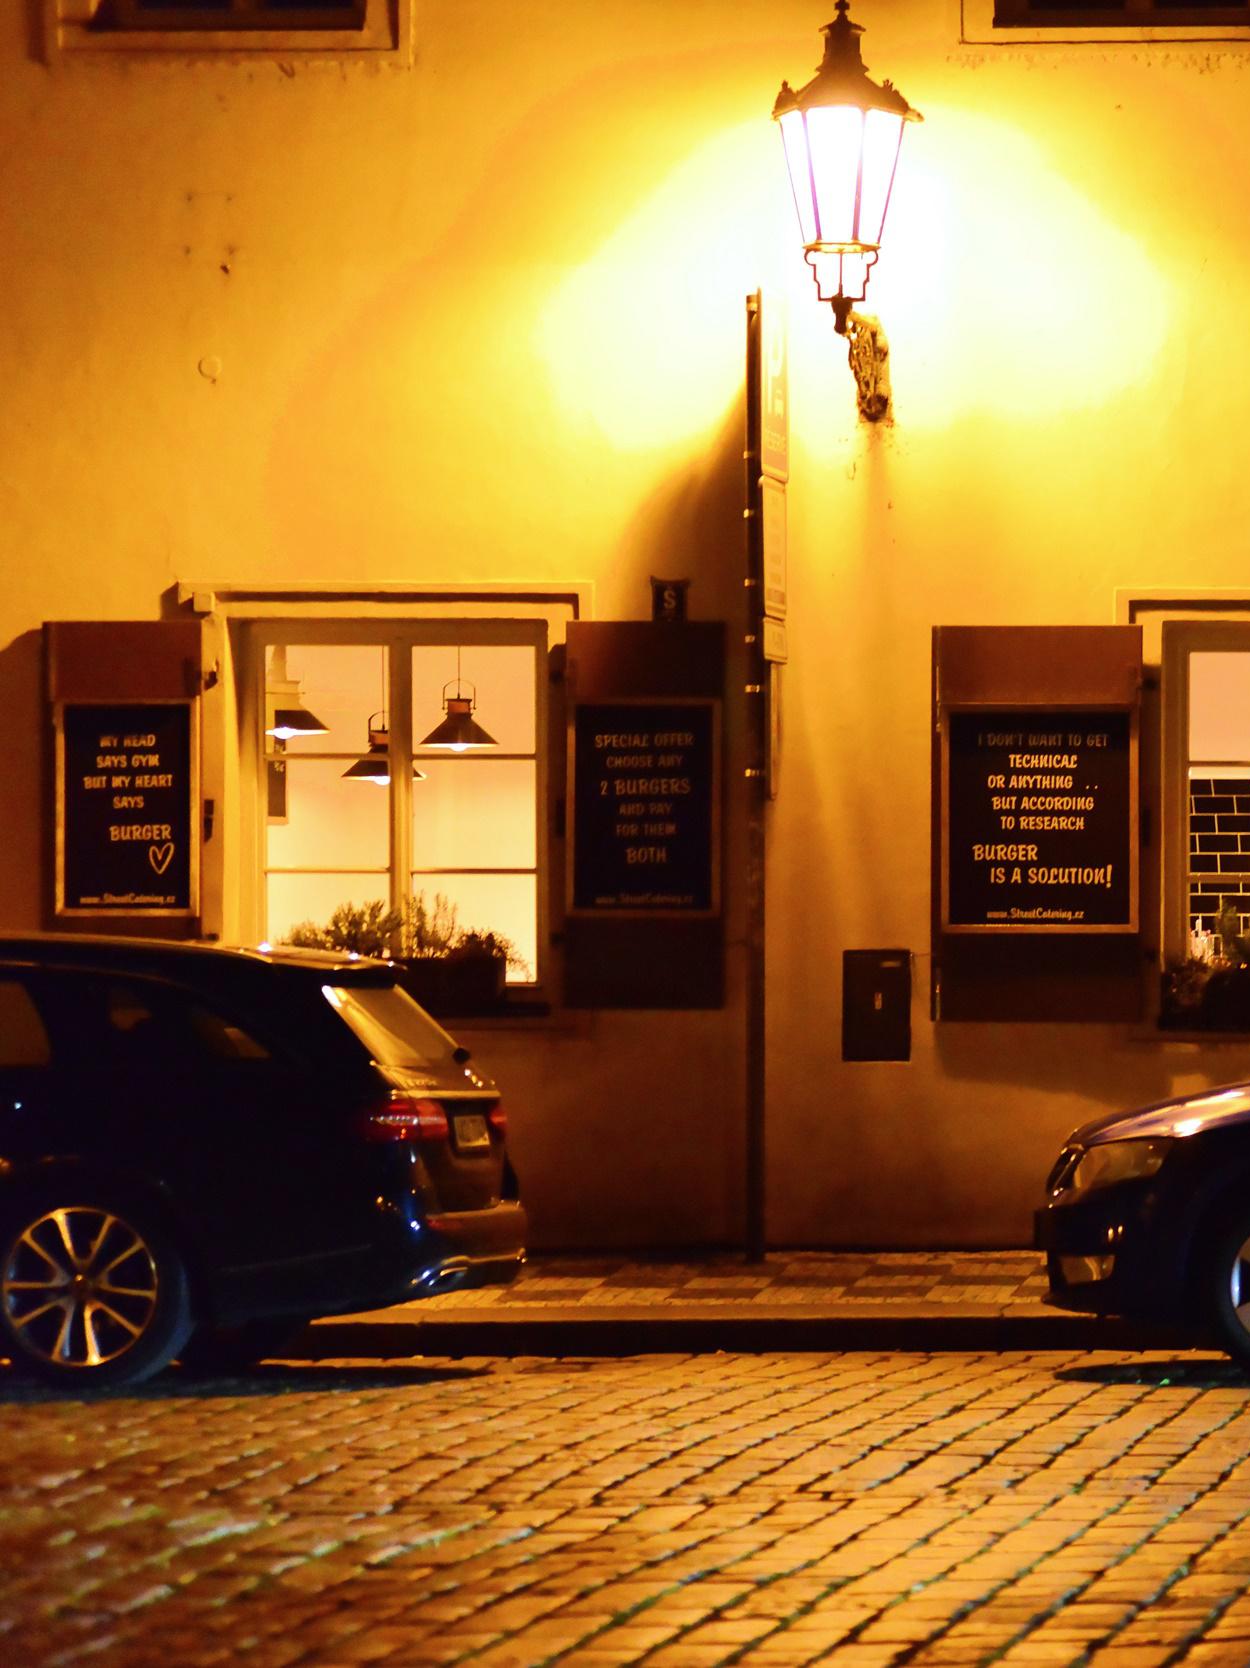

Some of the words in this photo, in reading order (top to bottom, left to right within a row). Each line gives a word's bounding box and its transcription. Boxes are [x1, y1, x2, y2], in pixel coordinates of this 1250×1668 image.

[123, 734, 156, 748] HEAD
[593, 733, 649, 750] SPECIAL
[653, 731, 695, 748] OFFER
[987, 733, 1023, 747] DON'T
[1028, 733, 1063, 748] WANT
[1068, 733, 1083, 748] TO
[1086, 733, 1109, 748] GET
[96, 754, 128, 769] SAYS
[131, 753, 160, 768] GYM
[605, 755, 654, 769] CHOOSE
[1009, 754, 1079, 769] TECHNICAL
[83, 775, 107, 790] BUT
[112, 775, 130, 789] MY
[135, 773, 174, 788] HEART
[600, 779, 609, 796] 2
[614, 778, 692, 796] BURGERS
[987, 775, 1005, 789] OR
[1008, 775, 1073, 790] ANYTHING
[112, 795, 145, 809] SAYS
[618, 802, 645, 817] AND
[648, 801, 673, 816] PAY
[991, 796, 1017, 811] BUT
[1020, 796, 1095, 811] ACCORDING
[616, 823, 639, 838] FOR
[643, 823, 678, 837] THEM
[1000, 816, 1015, 830] TO
[1019, 816, 1085, 831] RESEARCH
[109, 823, 172, 842] BURGER
[625, 846, 668, 864] BOTH
[972, 844, 1039, 861] BURGER
[990, 867, 1006, 884] IS
[1010, 867, 1022, 884] A
[1028, 864, 1113, 889] SOLUTION!
